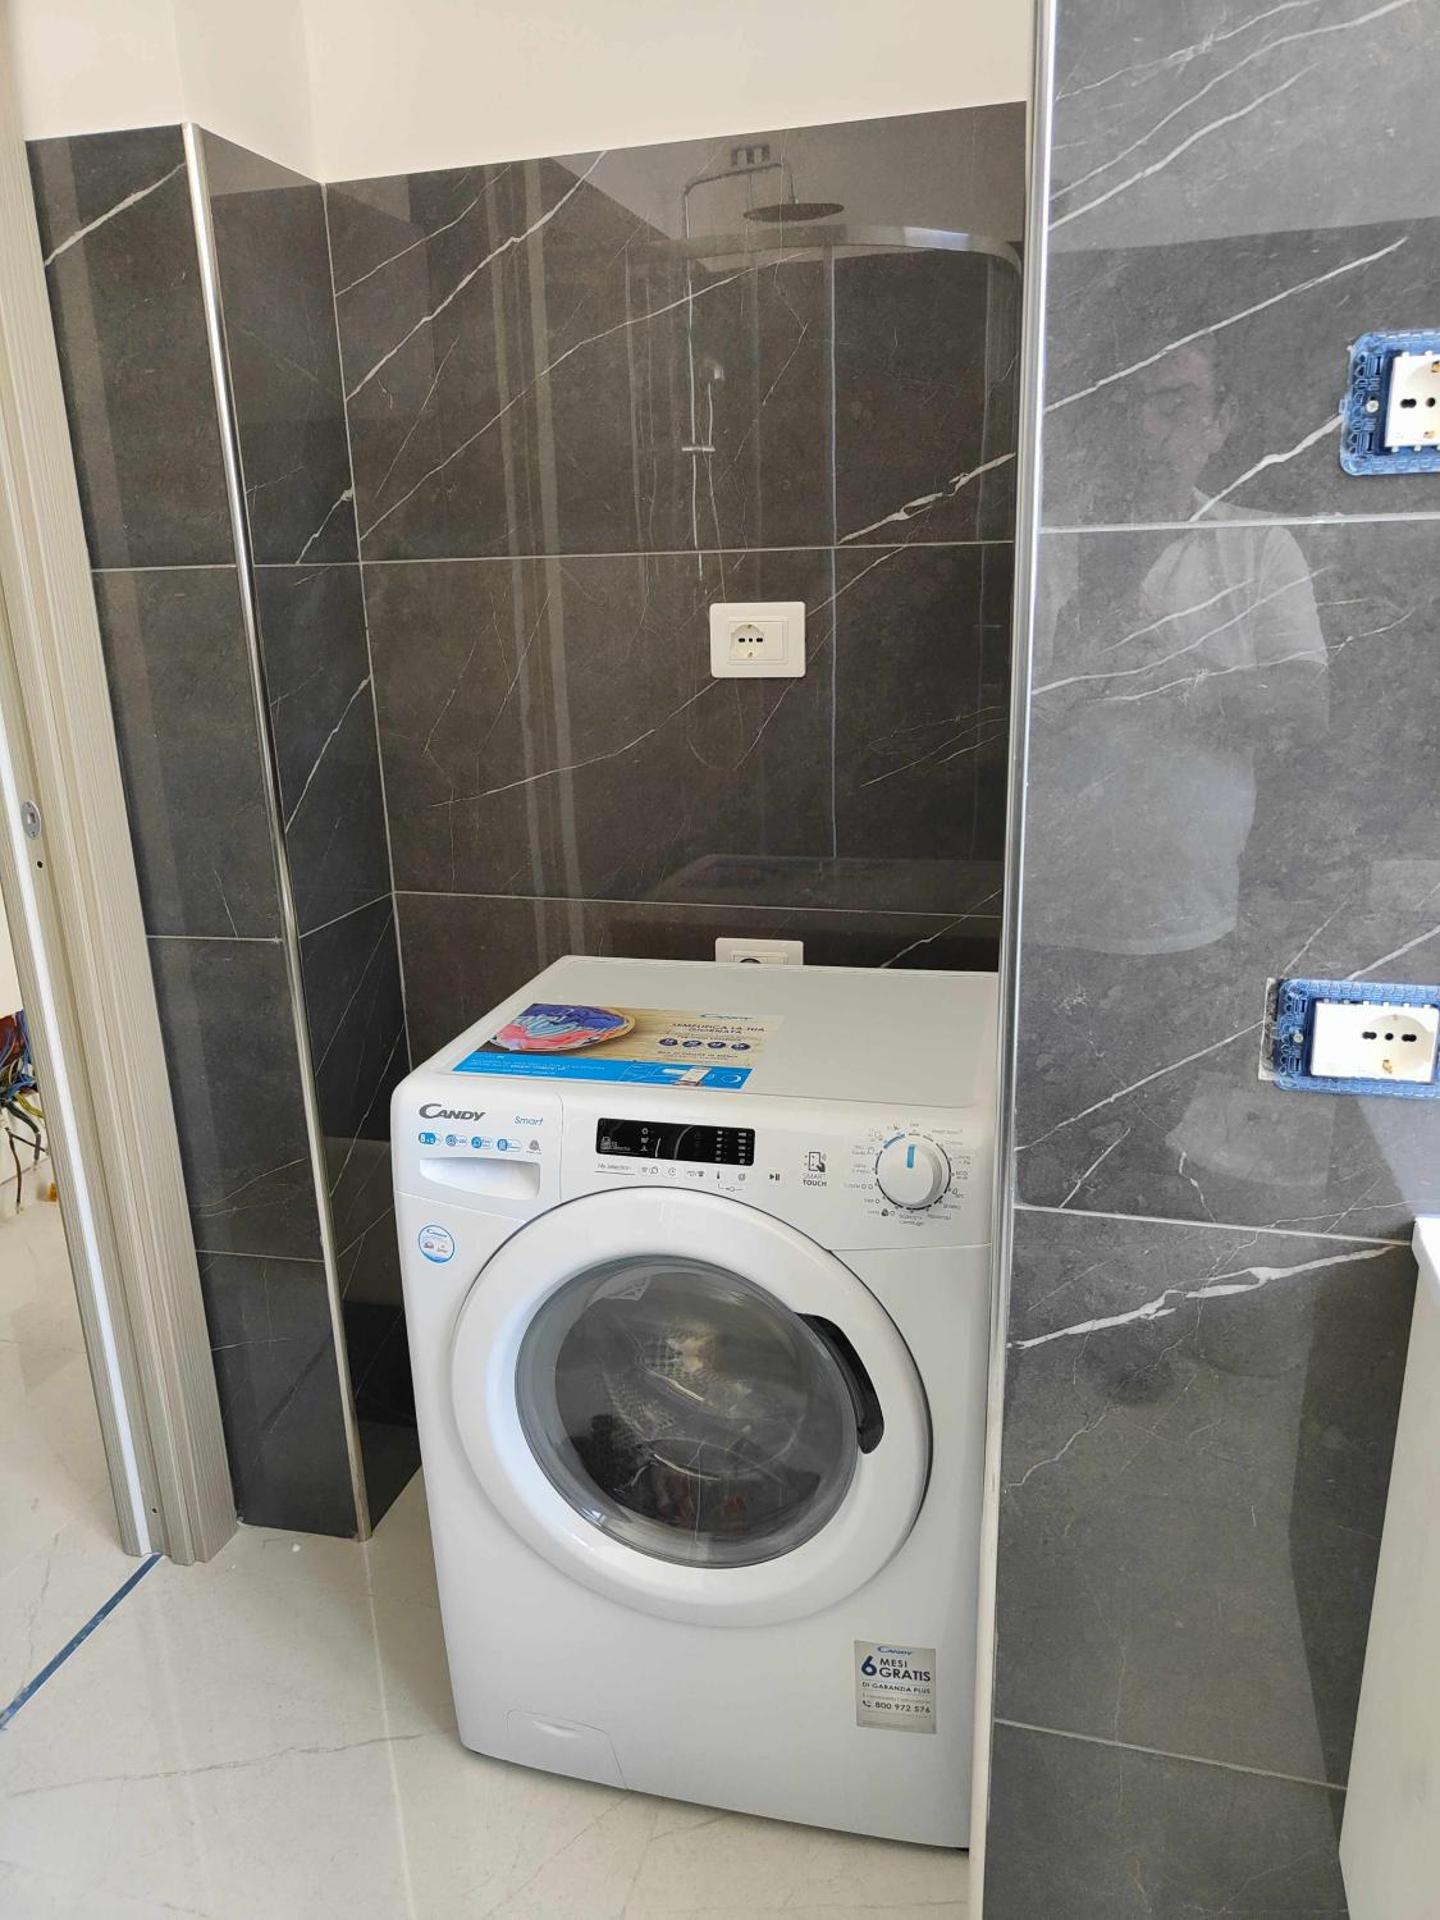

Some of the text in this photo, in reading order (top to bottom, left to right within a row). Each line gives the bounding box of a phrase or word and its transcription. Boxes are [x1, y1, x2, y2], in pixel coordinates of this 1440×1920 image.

[419, 1103, 486, 1121] CANDY
[514, 1115, 544, 1126] Smart
[861, 1655, 877, 1676] 6
[880, 1658, 908, 1668] MESI
[879, 1667, 931, 1682] GRATIS
[872, 1682, 912, 1693] GARANZIA
[875, 1701, 931, 1714] 800 972 576
